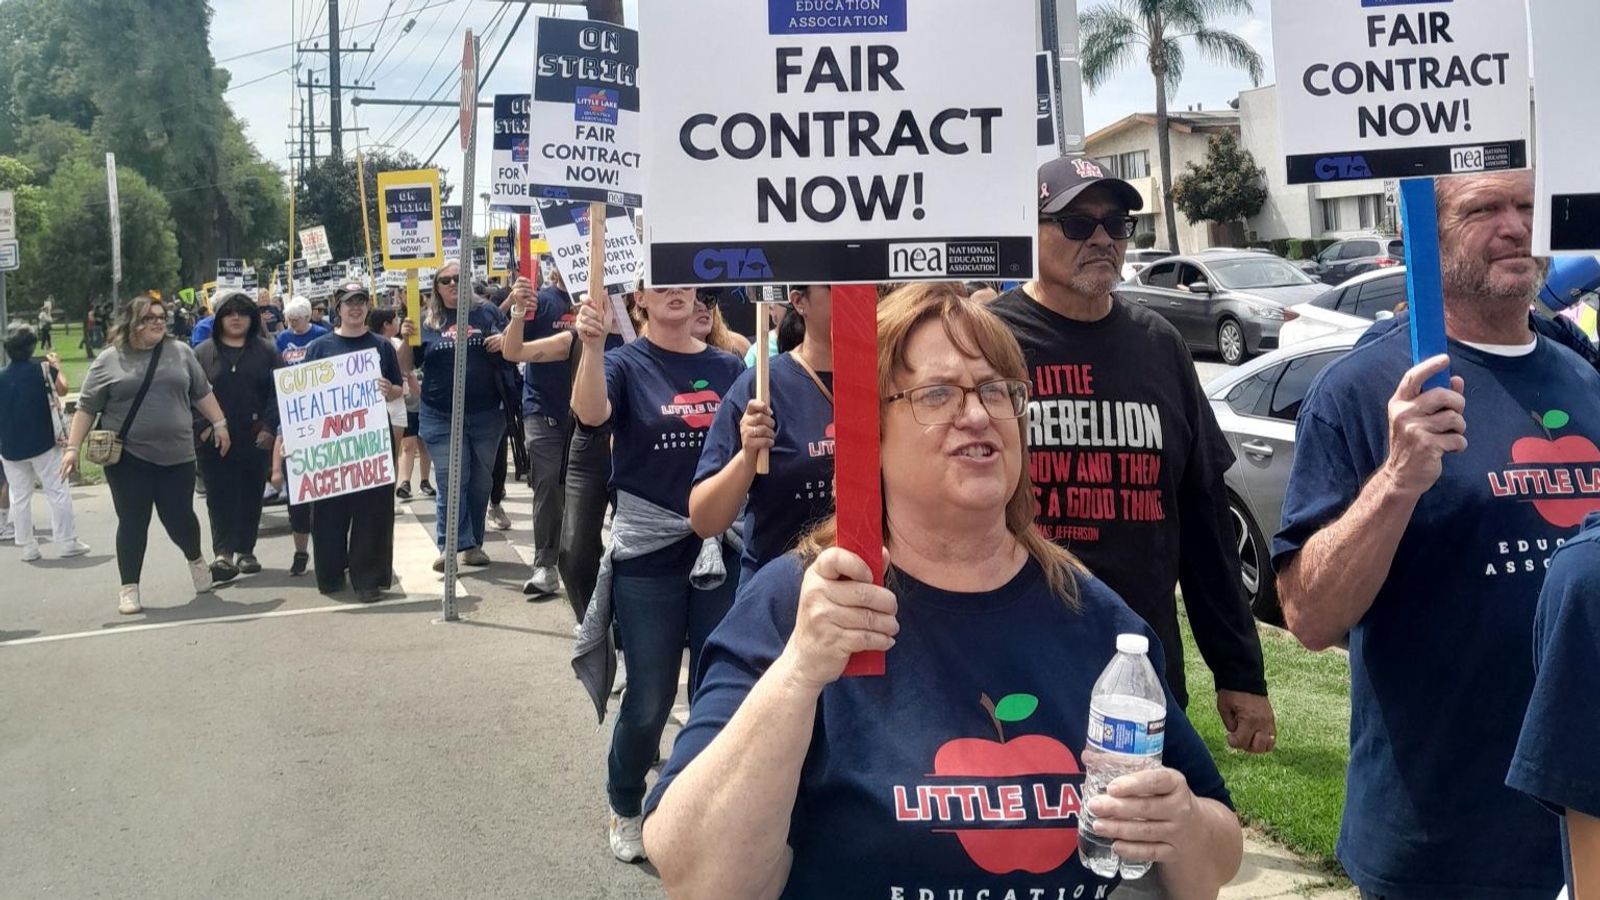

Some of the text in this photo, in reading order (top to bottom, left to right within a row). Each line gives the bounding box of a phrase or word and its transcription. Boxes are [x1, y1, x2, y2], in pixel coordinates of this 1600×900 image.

[796, 0, 880, 11] EDUCATION
[789, 15, 888, 28] ASSOCIATION
[1366, 11, 1454, 47] FAIR
[579, 27, 620, 54] ON
[775, 44, 905, 93] FAIR
[1302, 53, 1510, 96] CONTRACT
[577, 98, 618, 109] LITTLE LAKE
[1358, 98, 1472, 138] NOW!
[575, 125, 615, 143] FAIR
[679, 107, 1003, 161] CONTRACT
[542, 144, 641, 168] CONTRACT
[1314, 155, 1372, 179] CTA
[1453, 150, 1483, 169] nea
[499, 167, 519, 179] FOR
[566, 165, 620, 186] NOW!
[399, 192, 416, 201] ON
[494, 183, 527, 195] STUDE
[757, 172, 926, 223] NOW!
[386, 202, 431, 213] STRIKE
[391, 237, 430, 245] CONTRACT
[557, 235, 637, 258] OUR SDENTS
[948, 246, 996, 255] NATIONAL
[572, 249, 634, 270] AR ORTH
[692, 247, 774, 280] CTA
[893, 246, 943, 273] nea
[948, 255, 996, 263] EDUCATION
[948, 263, 996, 272] ASSOCIATION
[568, 262, 638, 284] FIGNG FO
[279, 352, 375, 395] CUTS OUR
[1036, 364, 1094, 396] LITTLE
[286, 378, 383, 425] HEALTHCARE
[661, 403, 705, 415] LITTLE
[296, 408, 368, 439] IS NOT
[1026, 400, 1163, 450] REBELLION
[654, 441, 701, 450] ASSOCI
[661, 432, 709, 440] EDUCA
[289, 427, 390, 476] SUSTAINABLE
[298, 454, 391, 502] ACCEPTABLE
[1028, 451, 1161, 484] NOW AND THEN
[1488, 468, 1574, 496] LITTLE
[1047, 488, 1060, 518] A
[1066, 487, 1115, 519] GOOD
[1055, 525, 1099, 540] JEFFERSON
[893, 783, 1084, 821] LITTLE LA
[889, 884, 1109, 900] EDUCATION
